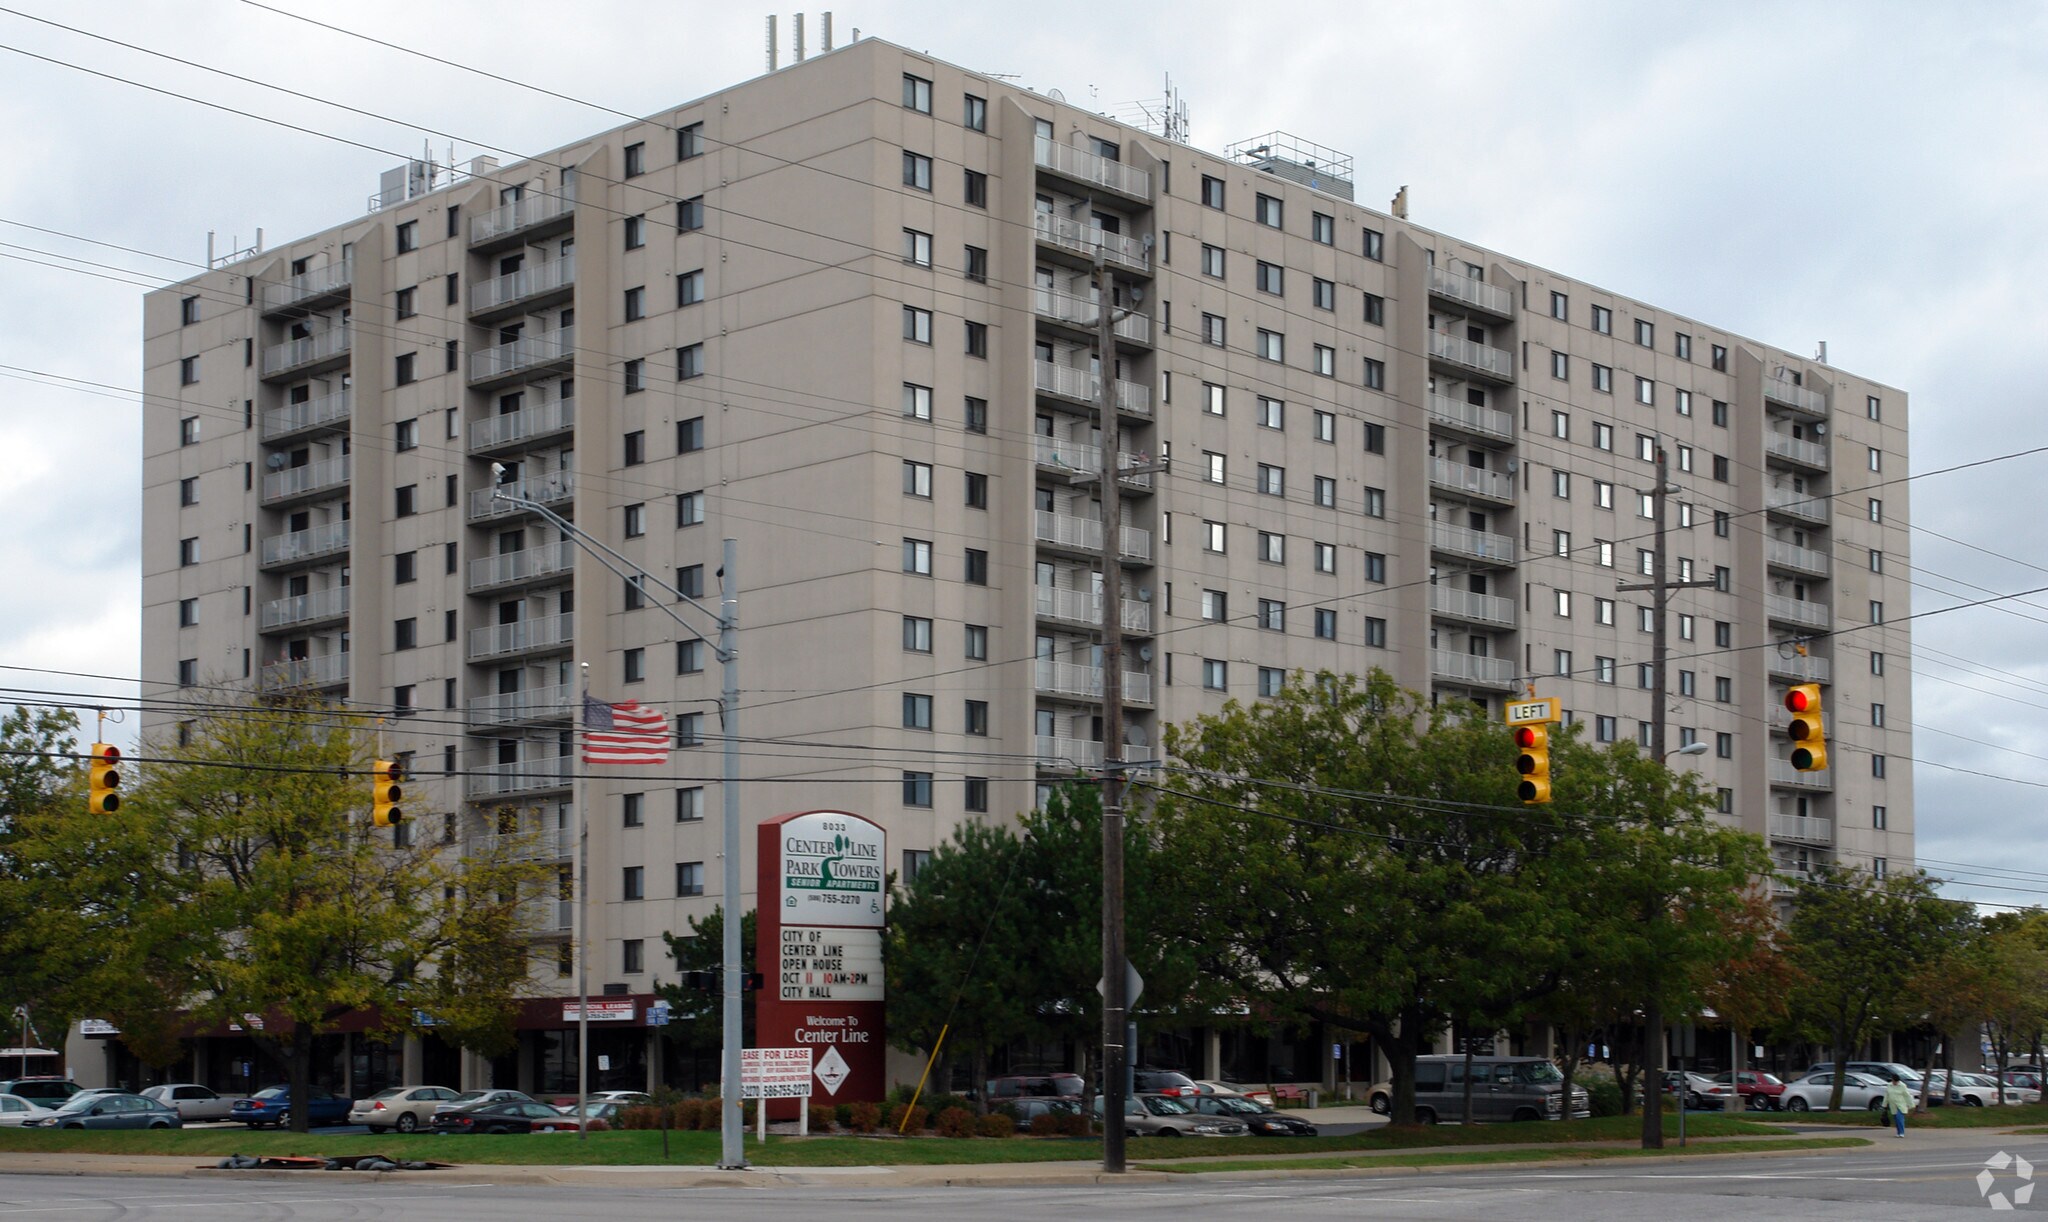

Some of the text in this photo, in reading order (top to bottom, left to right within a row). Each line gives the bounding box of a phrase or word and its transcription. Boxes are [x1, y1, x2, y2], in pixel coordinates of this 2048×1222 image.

[1514, 704, 1545, 719] LEFT
[822, 822, 846, 831] 8033
[786, 837, 877, 857] CENTER LINE
[786, 859, 880, 879] PARK TOWERS
[790, 878, 876, 890] SENIOR APARTMENTS
[822, 893, 861, 905] 755-2270
[782, 930, 822, 942] CITY OF
[782, 944, 843, 957] CENTER LINE
[782, 958, 842, 970] OPEN HOUSE
[782, 972, 800, 984] OCT
[782, 986, 832, 998] CITY HALL
[806, 1015, 859, 1026] Welcome To
[794, 1028, 869, 1043] Center Line
[764, 1050, 809, 1060] FOR LEASE
[764, 1083, 810, 1097] 586-755-2270
